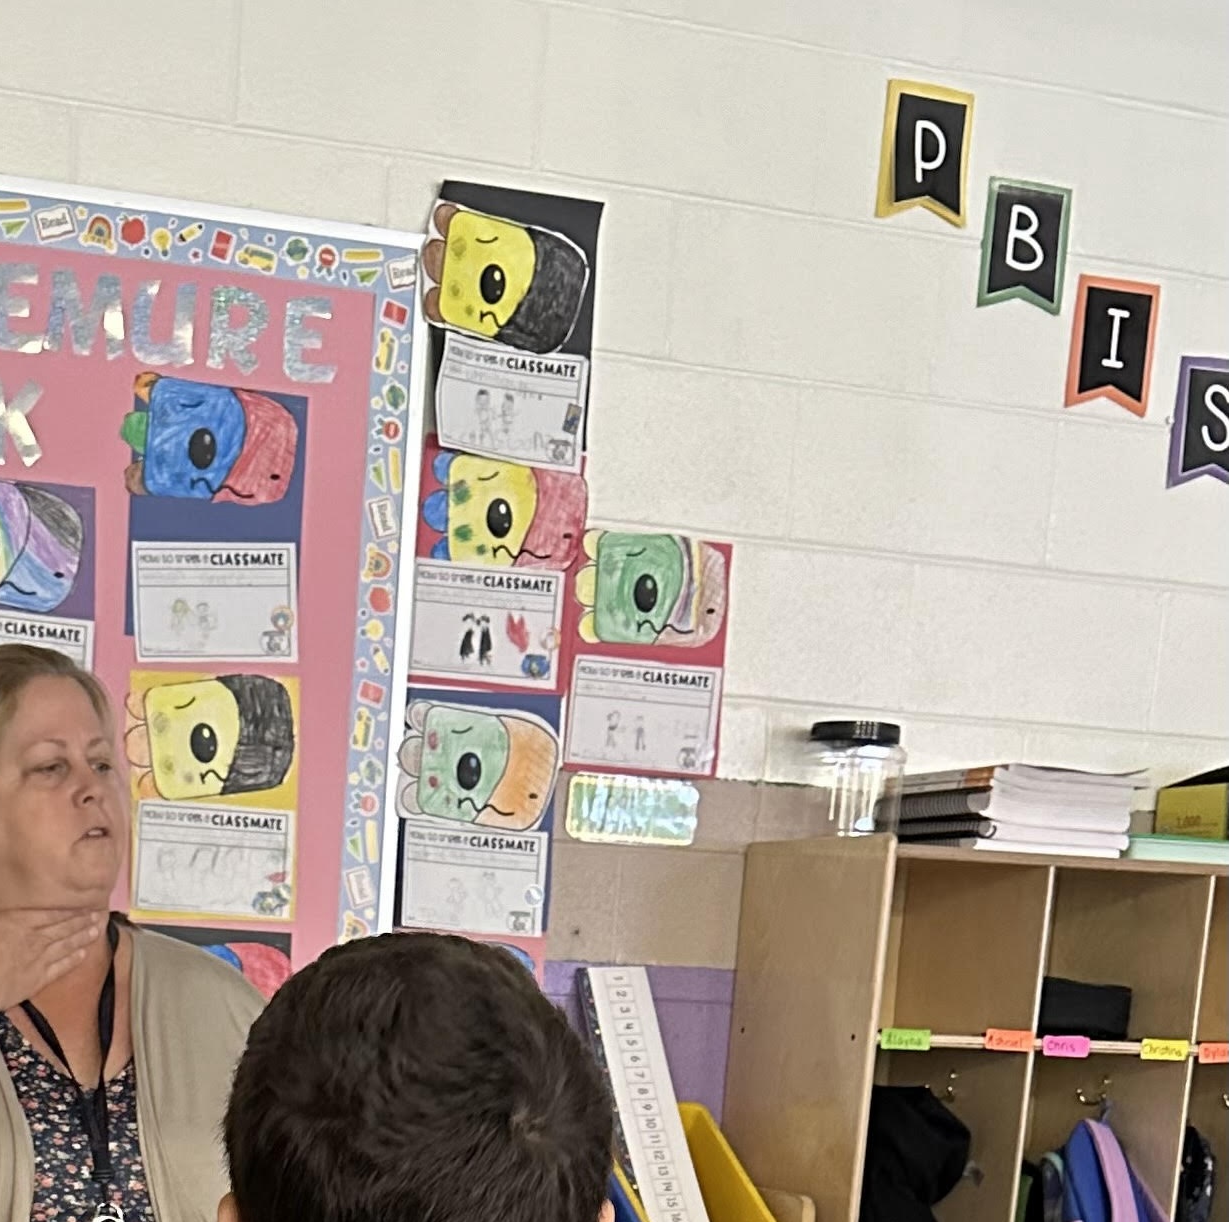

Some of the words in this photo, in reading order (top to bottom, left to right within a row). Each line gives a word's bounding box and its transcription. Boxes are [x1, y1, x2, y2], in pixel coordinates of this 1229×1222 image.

[914, 119, 947, 183] P
[1005, 204, 1045, 271] B
[1101, 308, 1130, 369] I
[1201, 383, 1229, 451] S
[506, 357, 577, 378] CLASSMATE
[210, 552, 284, 566] CLASSMATE
[483, 575, 553, 593] CLASSMATE
[4, 622, 81, 642] CLASSMATE
[642, 671, 710, 688] CLASSMATE
[211, 814, 283, 831] CLASSMATE
[470, 835, 536, 853] CLASSMATE
[616, 990, 627, 998] 2
[620, 1006, 630, 1014] 3
[624, 1022, 634, 1030] 4
[626, 1039, 638, 1047] 5
[634, 1071, 645, 1079] 7
[637, 1087, 649, 1095] 8
[642, 1103, 652, 1111] 9
[646, 1117, 657, 1129] 10
[650, 1134, 661, 1144] 11
[653, 1150, 665, 1160] 12
[658, 1165, 669, 1176] 13
[662, 1181, 673, 1192] 14
[666, 1197, 678, 1208] 15
[671, 1212, 681, 1222] 16
